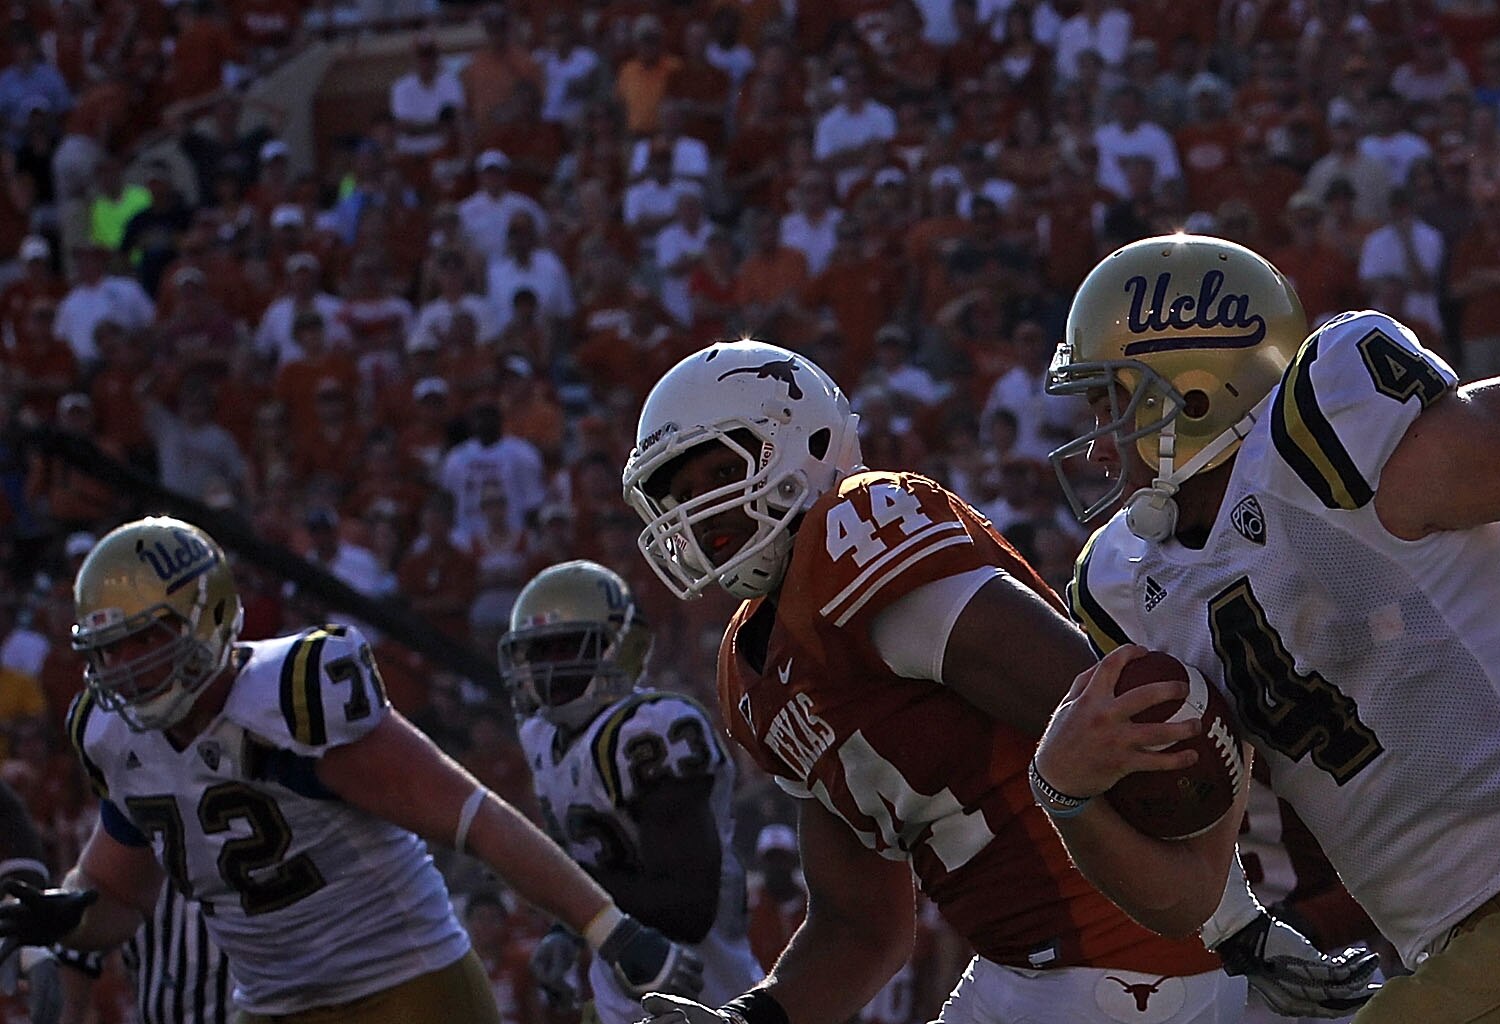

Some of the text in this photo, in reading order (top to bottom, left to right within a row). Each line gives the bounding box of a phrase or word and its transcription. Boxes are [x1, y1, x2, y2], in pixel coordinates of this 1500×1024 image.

[1124, 270, 1262, 338] Ucla
[1356, 327, 1448, 413] 4
[826, 482, 934, 568] 44
[1208, 575, 1385, 786] 4
[624, 716, 711, 782] 23
[763, 691, 836, 781] TEXAS
[125, 781, 326, 917] 72
